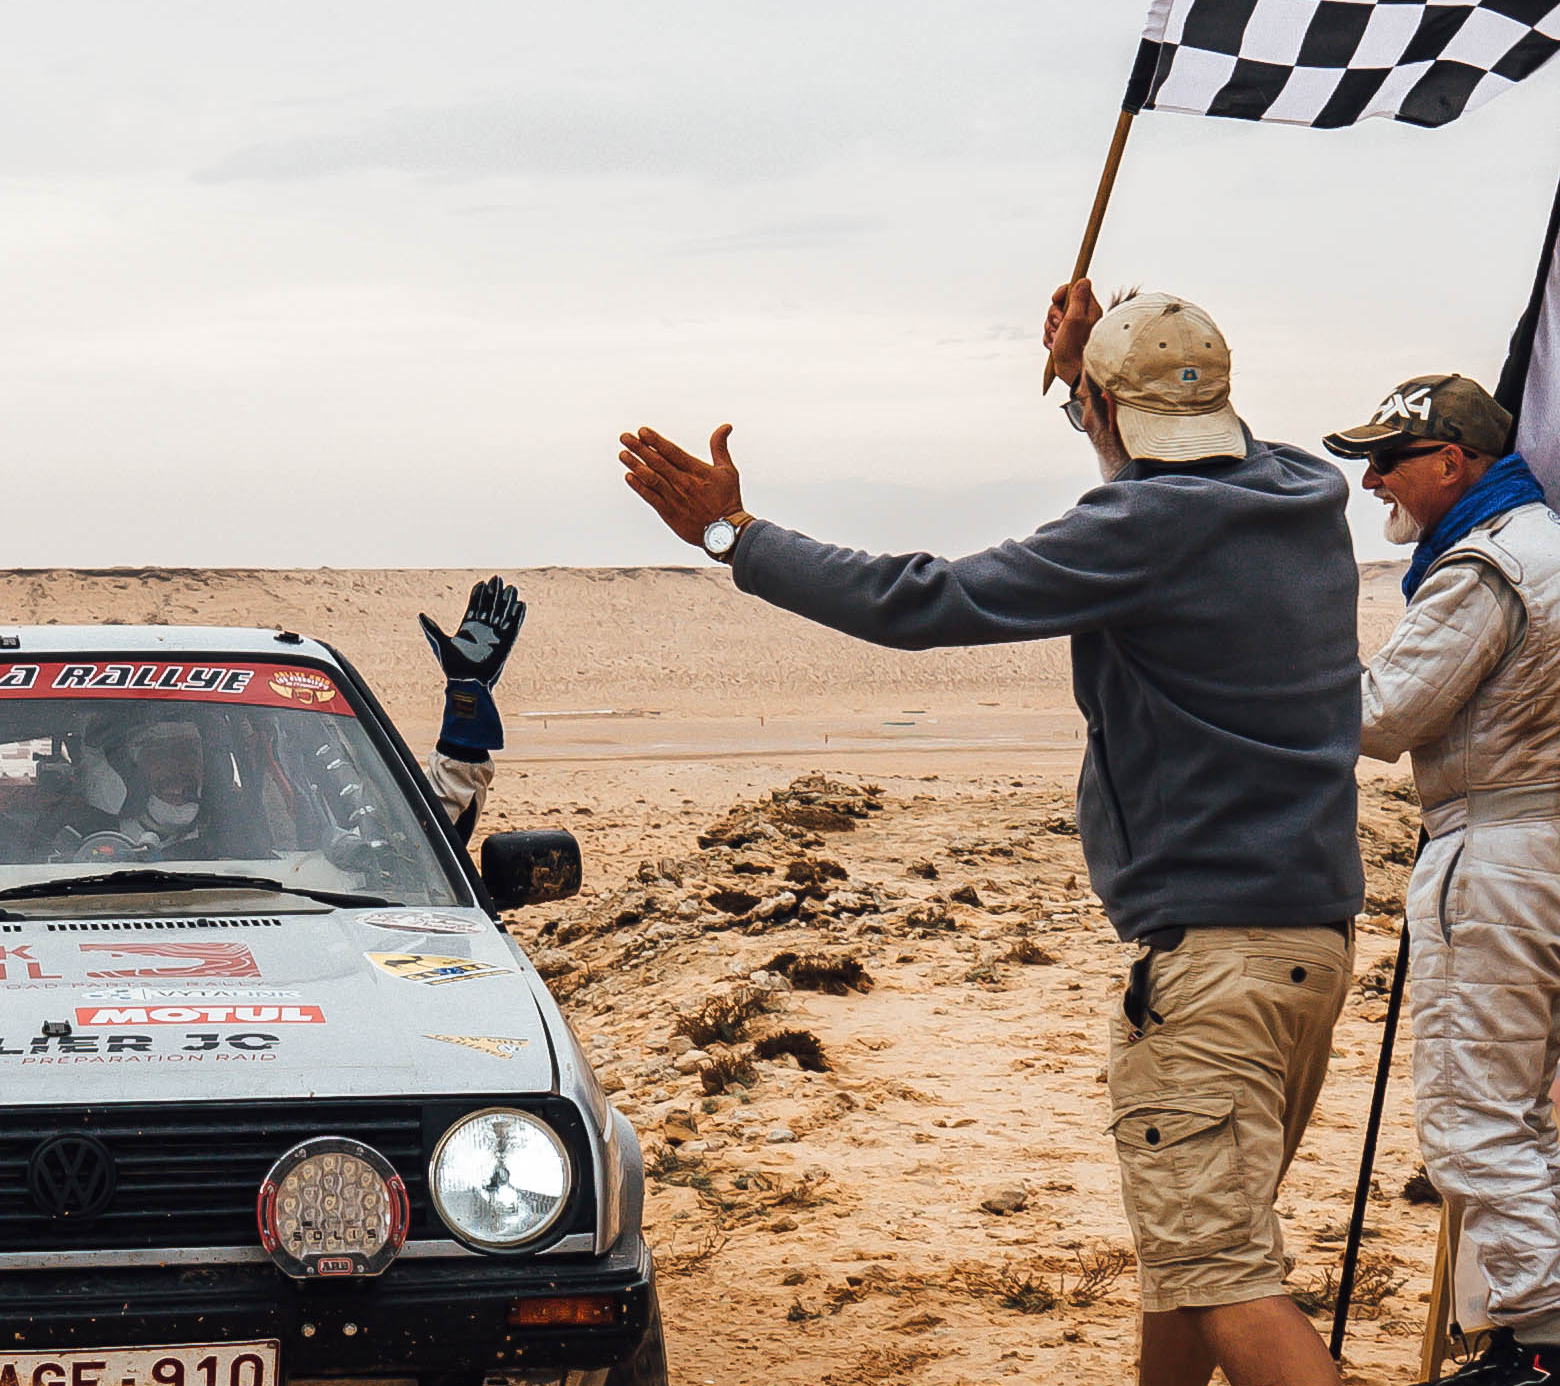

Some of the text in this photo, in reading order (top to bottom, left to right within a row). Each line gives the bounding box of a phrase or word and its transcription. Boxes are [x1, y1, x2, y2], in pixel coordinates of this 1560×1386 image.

[52, 665, 254, 693] RALLYE
[90, 1007, 313, 1023] MOTUL
[215, 1053, 277, 1062] RAID
[293, 1228, 376, 1241] SOLIS
